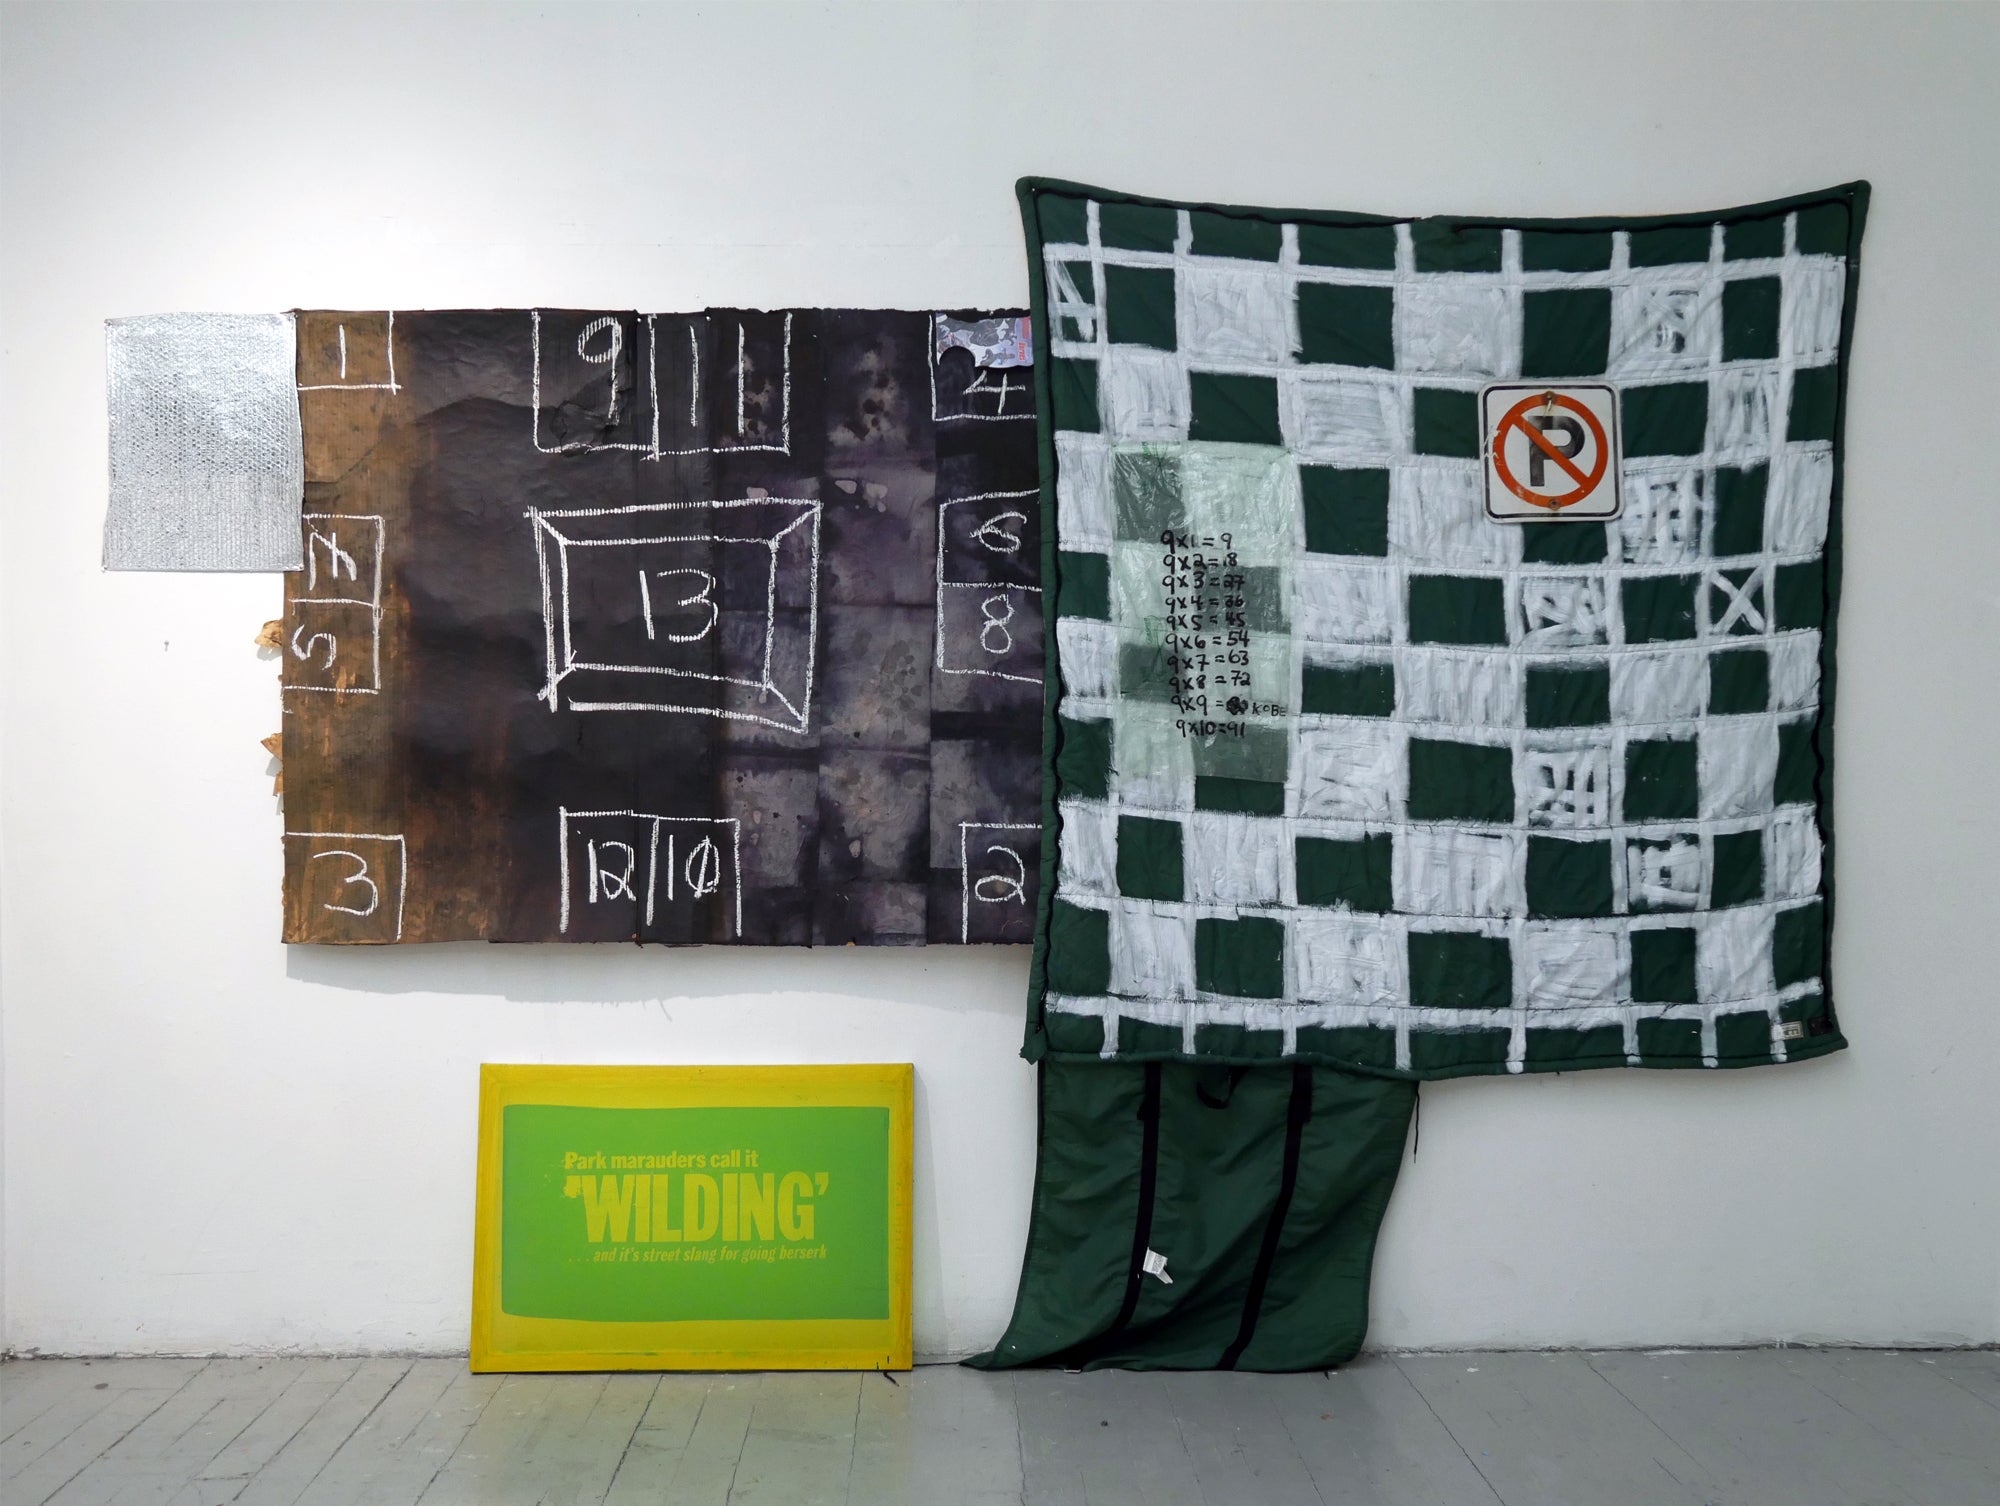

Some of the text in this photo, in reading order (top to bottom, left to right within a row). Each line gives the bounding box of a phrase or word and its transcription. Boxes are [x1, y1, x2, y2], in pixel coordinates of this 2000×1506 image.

[338, 323, 347, 380] 1
[577, 316, 623, 426] 9
[688, 322, 746, 438] 11
[962, 369, 1026, 415] 4
[1527, 415, 1586, 487] P
[639, 568, 719, 643] 13
[980, 592, 1014, 654] 8
[312, 850, 379, 917] 3
[587, 838, 637, 904] 12
[974, 846, 1026, 906] 2
[564, 1149, 760, 1170] Park marauders call it
[593, 1247, 618, 1262] and
[620, 1247, 641, 1262] it's
[643, 1247, 681, 1262] street
[683, 1246, 718, 1264] slang
[719, 1246, 740, 1261] for
[741, 1245, 778, 1263] going
[779, 1243, 828, 1261] berserk
